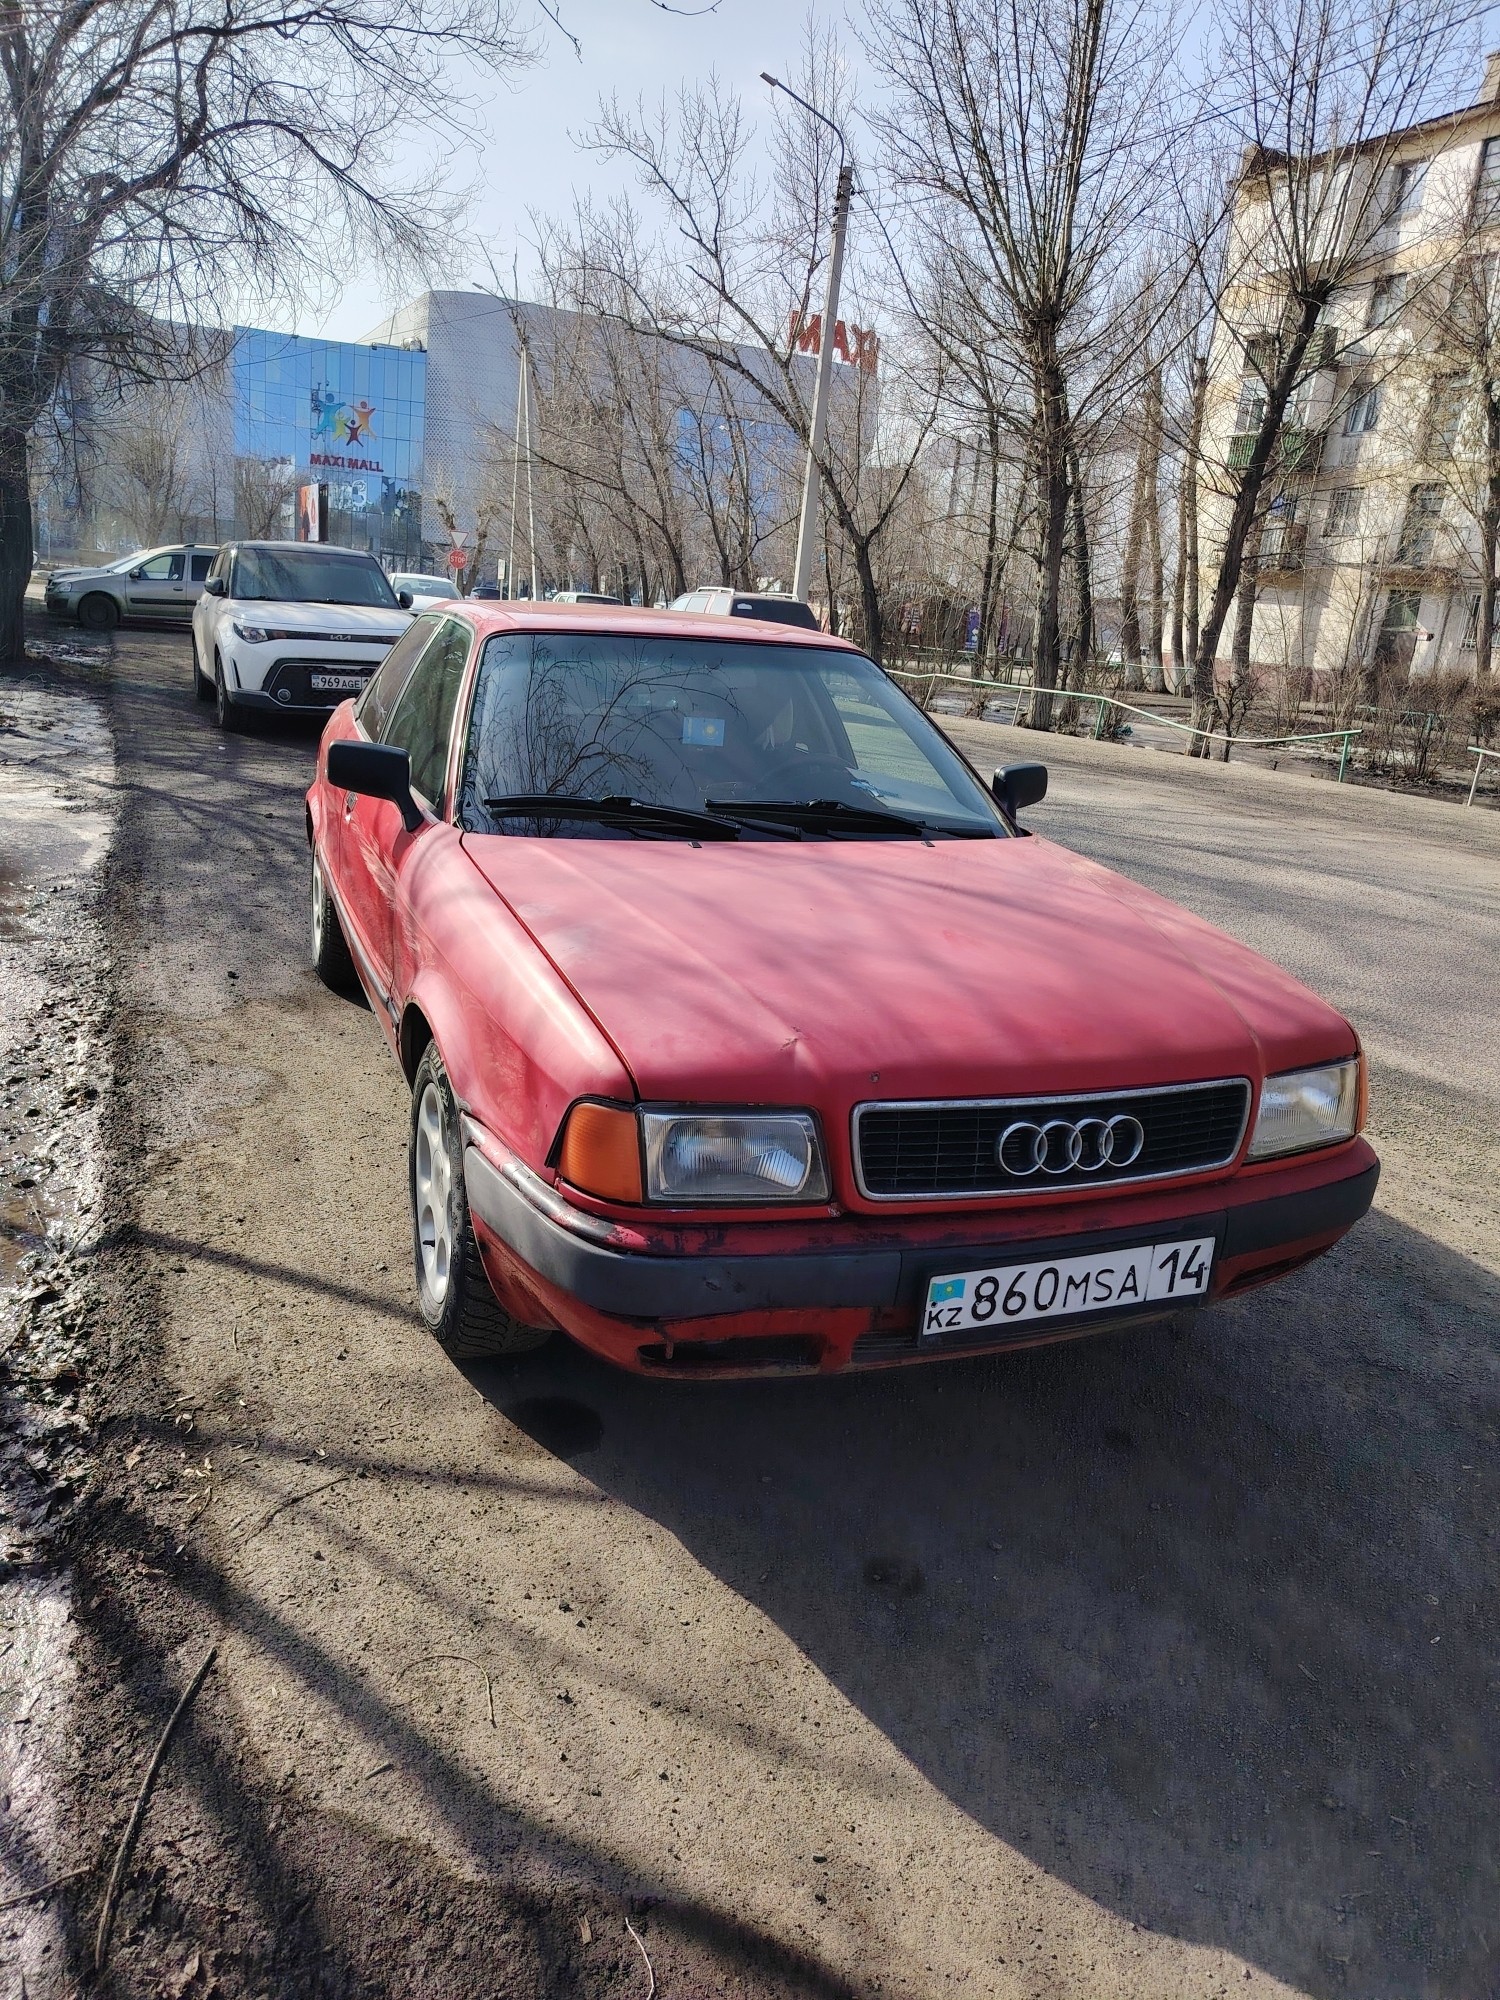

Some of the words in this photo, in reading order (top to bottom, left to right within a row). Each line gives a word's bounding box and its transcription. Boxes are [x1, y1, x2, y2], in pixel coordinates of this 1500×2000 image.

[310, 454, 344, 468] MAXI
[347, 457, 384, 472] MALL
[450, 555, 466, 563] STOP
[1158, 1244, 1206, 1293] 14
[927, 1307, 963, 1330] KZ
